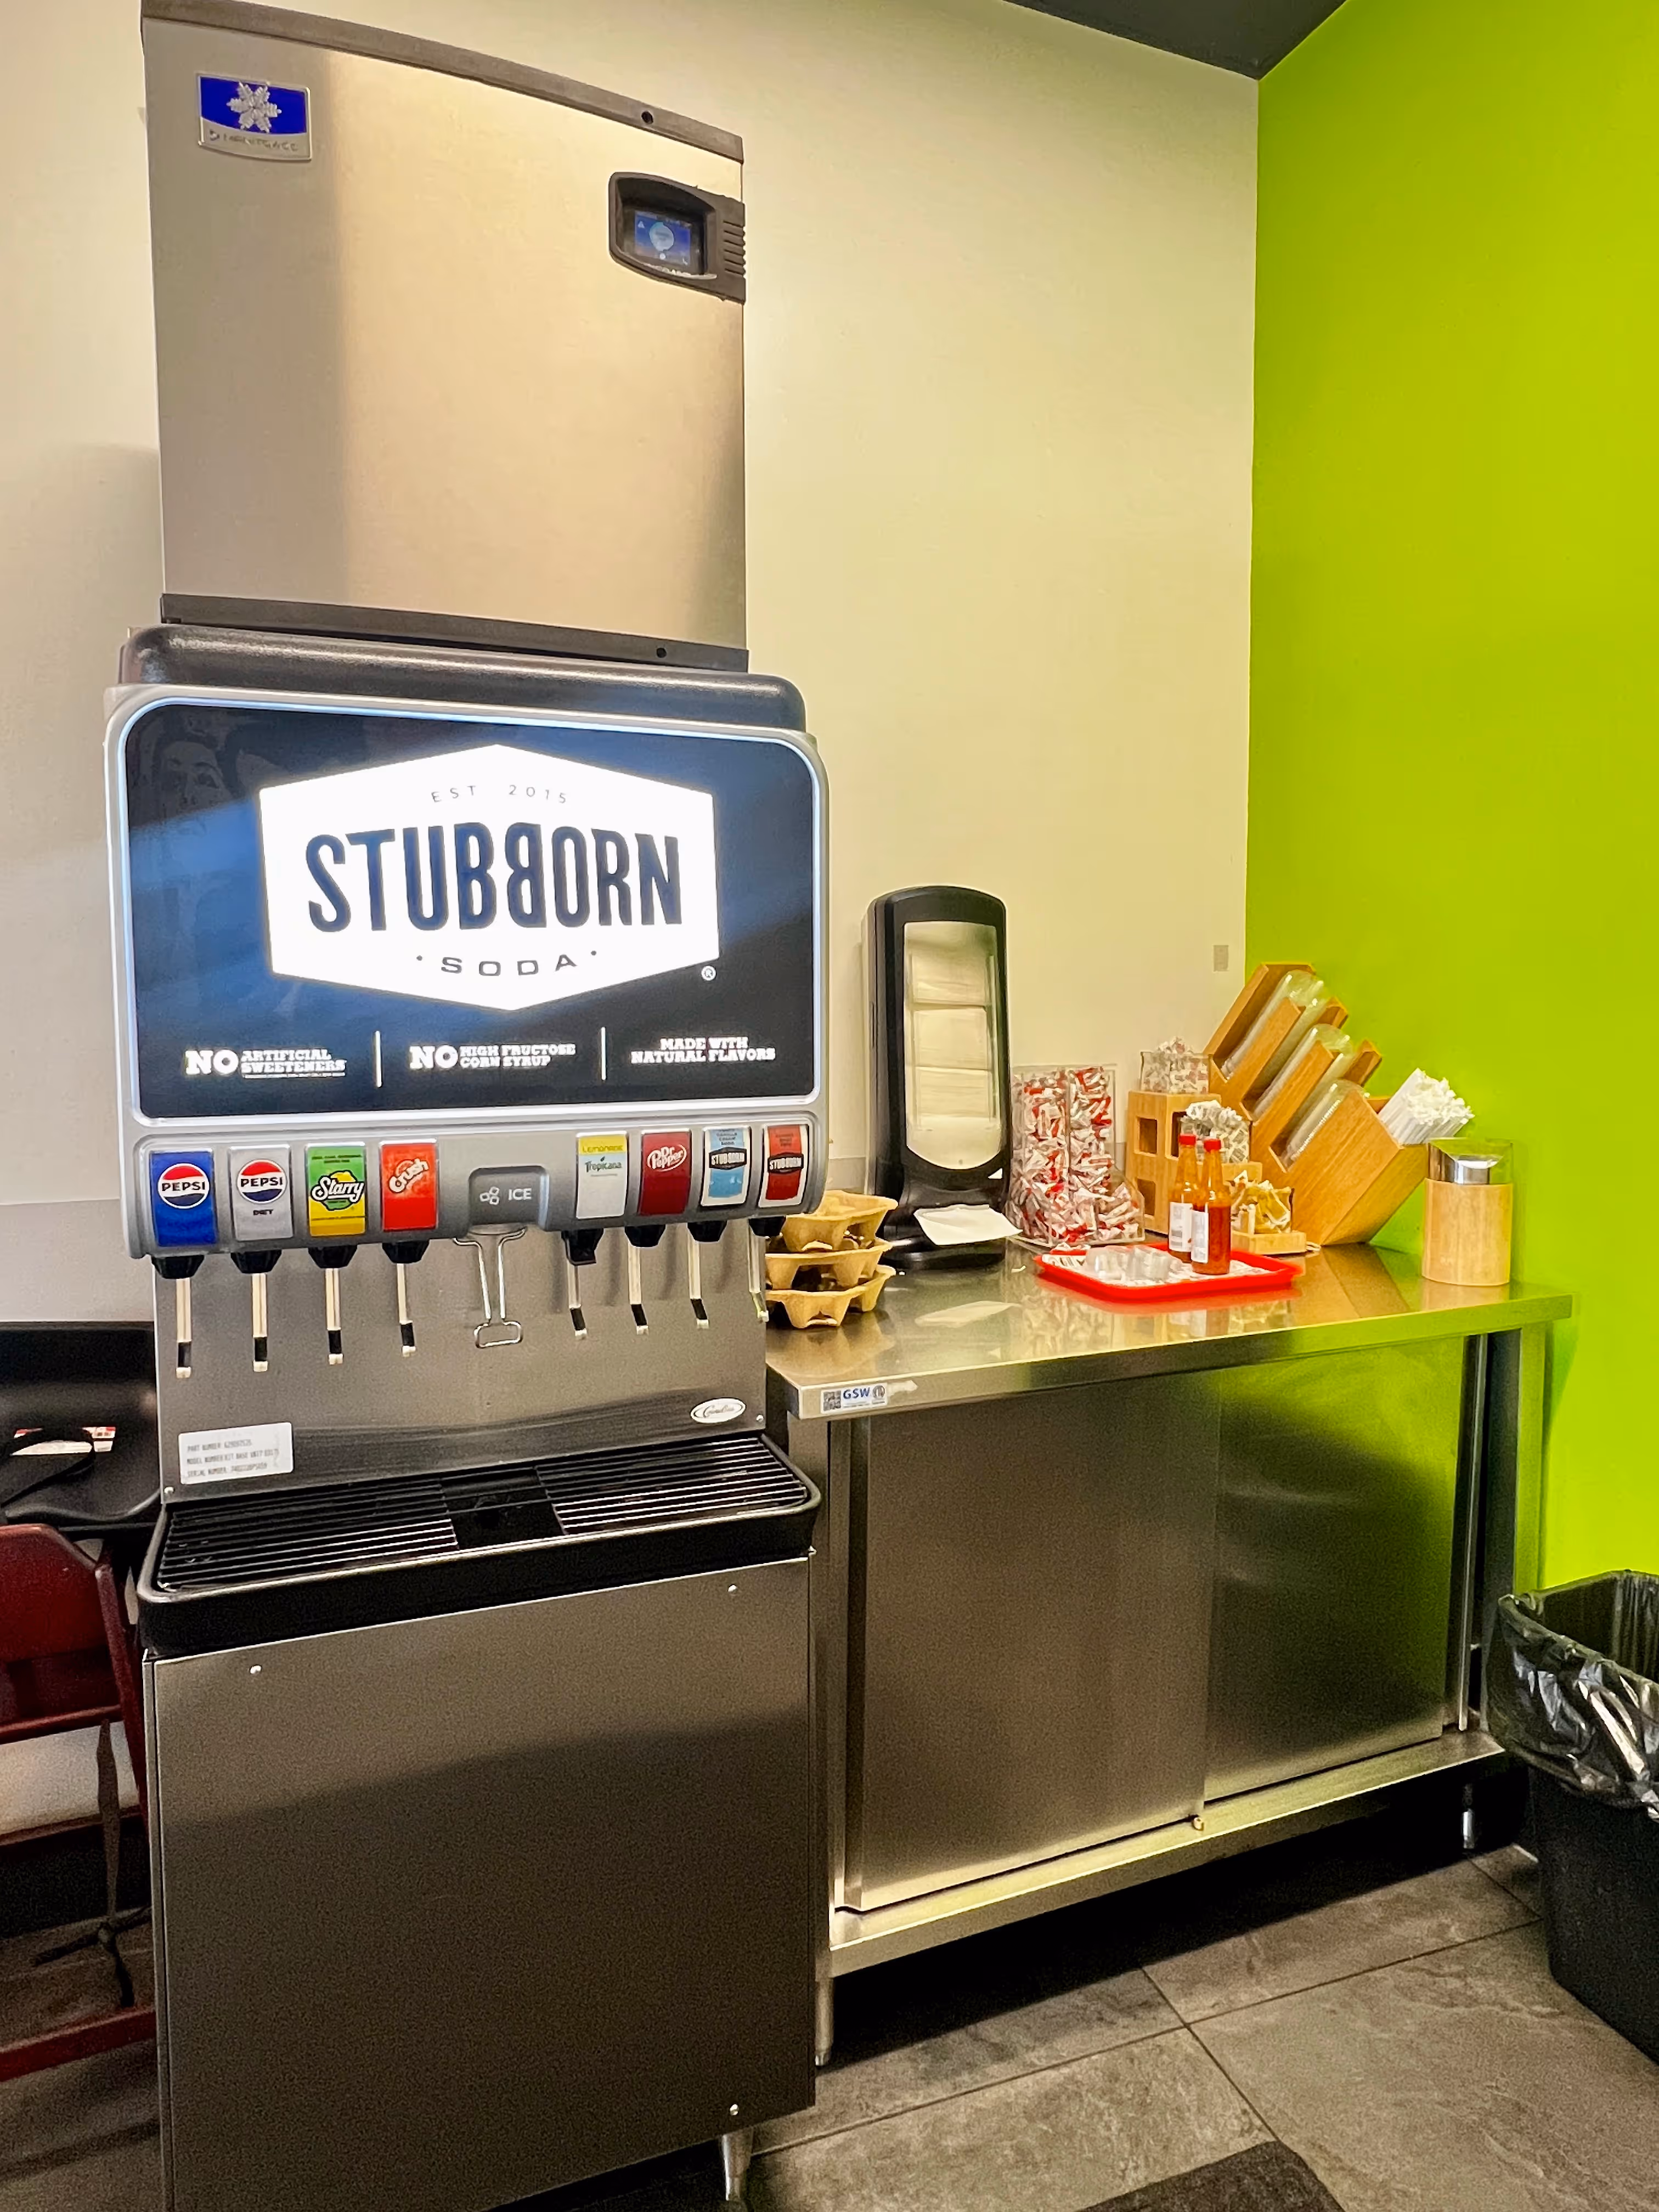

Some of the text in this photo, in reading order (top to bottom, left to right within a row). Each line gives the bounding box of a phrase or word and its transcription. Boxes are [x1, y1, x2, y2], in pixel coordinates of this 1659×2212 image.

[431, 785, 568, 804] EST 2015
[305, 821, 682, 933] STUBBORN
[440, 953, 577, 977] SODA
[460, 1043, 576, 1057] HIGH FRUCTOSE
[660, 1036, 748, 1050] MADE WITH
[185, 1049, 239, 1075] NO
[242, 1049, 331, 1061] ARTIFICIAL
[409, 1045, 459, 1070] NO
[460, 1055, 551, 1069] CORN SYRUP
[631, 1047, 776, 1064] NATURAL FLAVORS
[241, 1060, 347, 1073] SWEETENERS
[652, 1150, 684, 1169] Pepper
[711, 1152, 746, 1166] STUB
[769, 1156, 803, 1171] STUB
[161, 1181, 206, 1192] PEPSI
[240, 1177, 284, 1187] PEPSI
[311, 1176, 365, 1203] Starry
[508, 1188, 532, 1200] ICE
[843, 1387, 870, 1400] GSW
